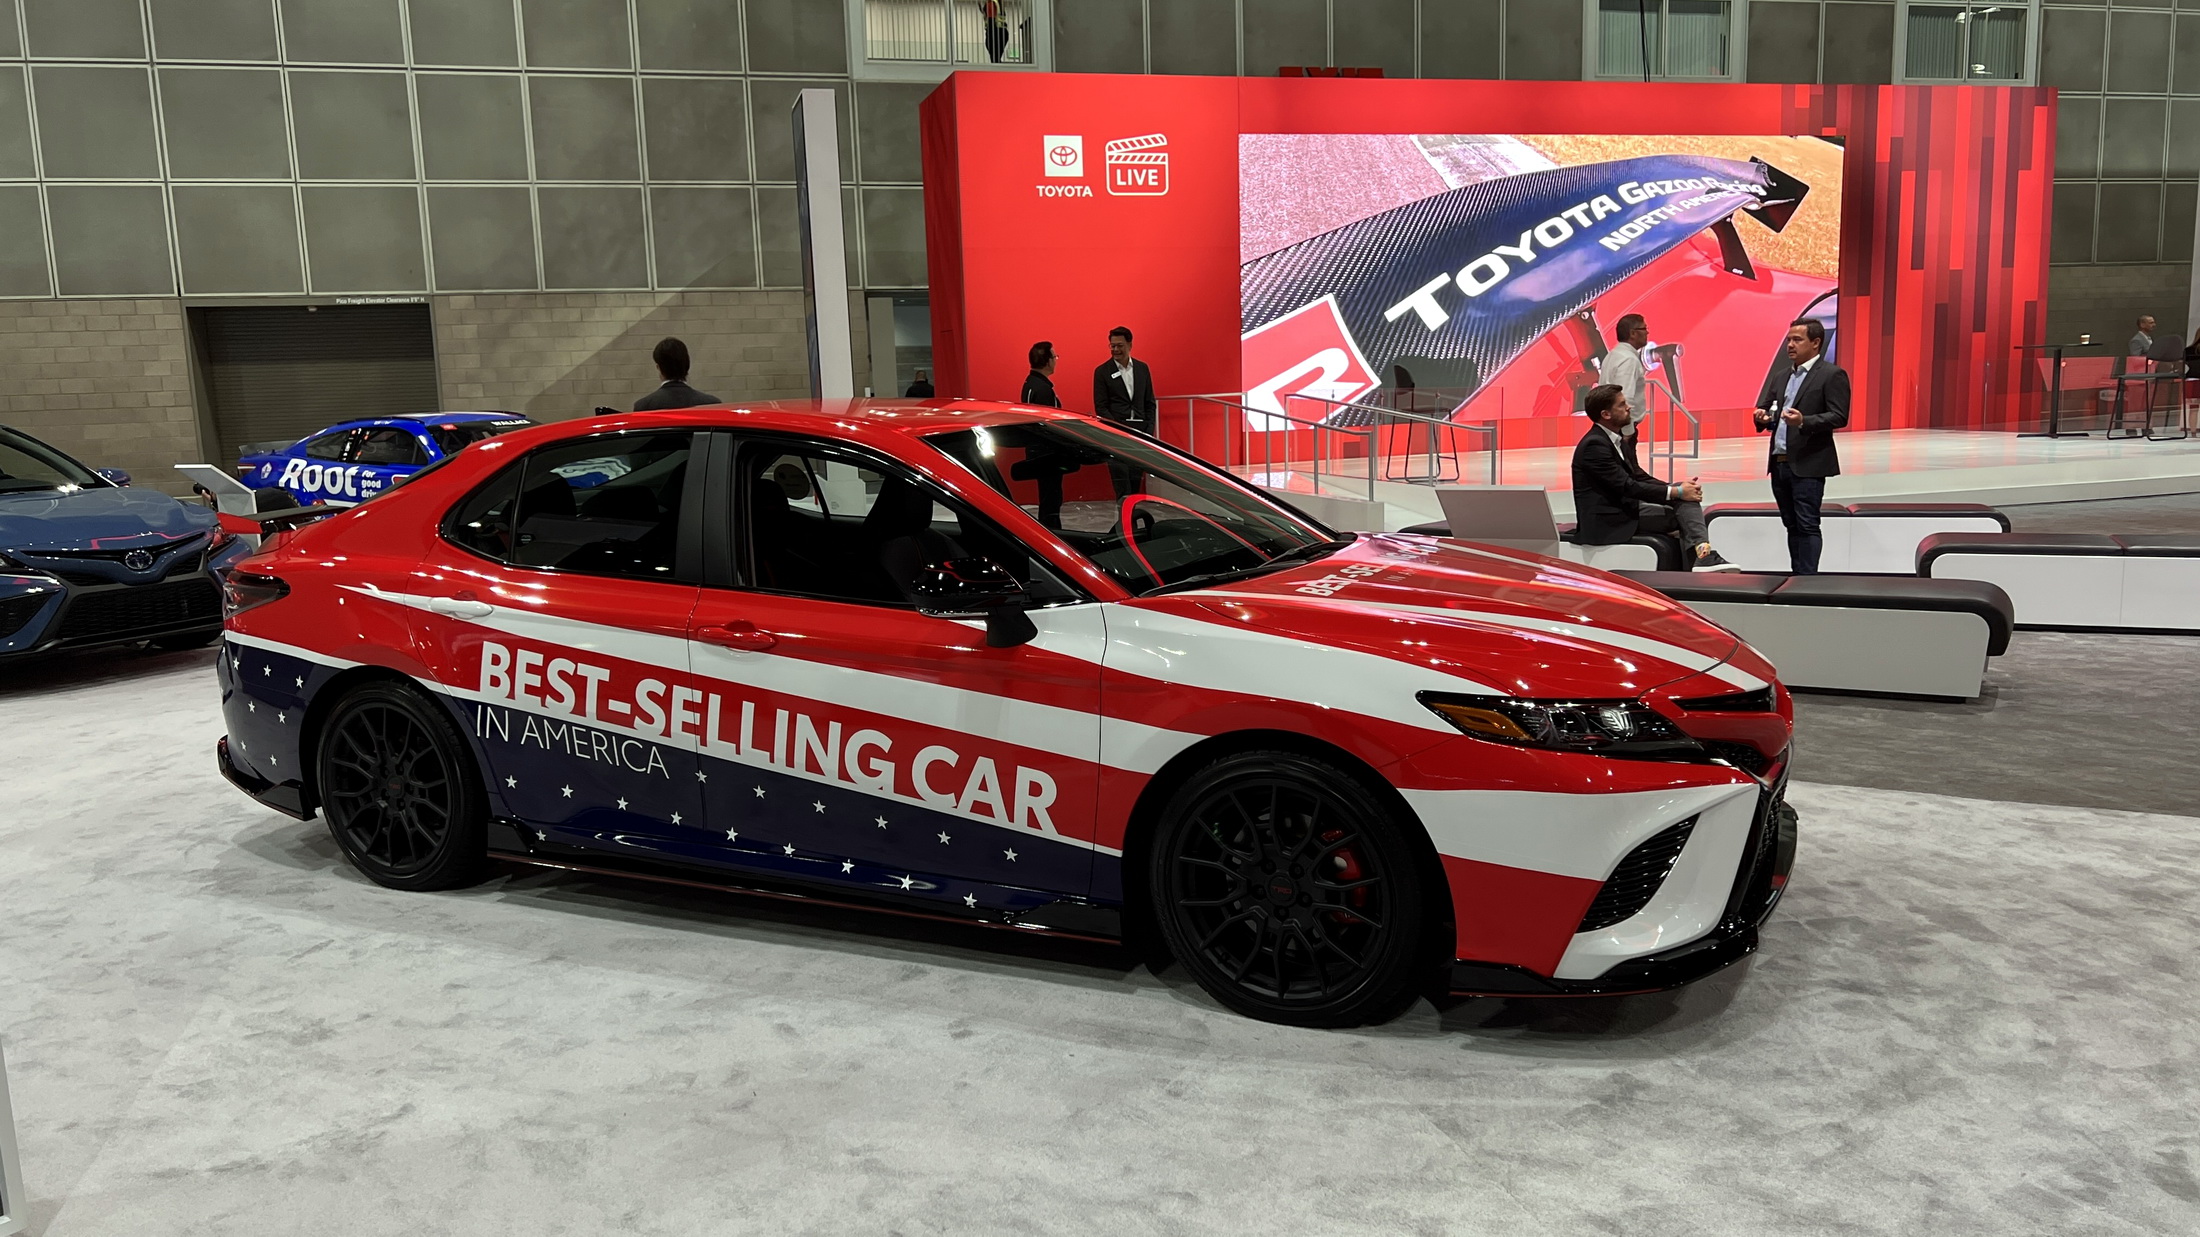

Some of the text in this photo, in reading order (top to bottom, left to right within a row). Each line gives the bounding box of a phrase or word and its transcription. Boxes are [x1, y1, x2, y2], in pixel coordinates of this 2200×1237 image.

[1116, 169, 1159, 186] LIVE
[1036, 185, 1093, 197] TOYOTA
[1598, 204, 1684, 252] NORTH
[1383, 194, 1622, 332] TOYOTA
[1617, 178, 1704, 205] GAZOO
[347, 297, 365, 305] Freight
[361, 479, 382, 489] good
[361, 489, 377, 498] driv
[476, 704, 669, 779] IN AMERICA
[479, 641, 1060, 837] BEST-SELLING CAR
